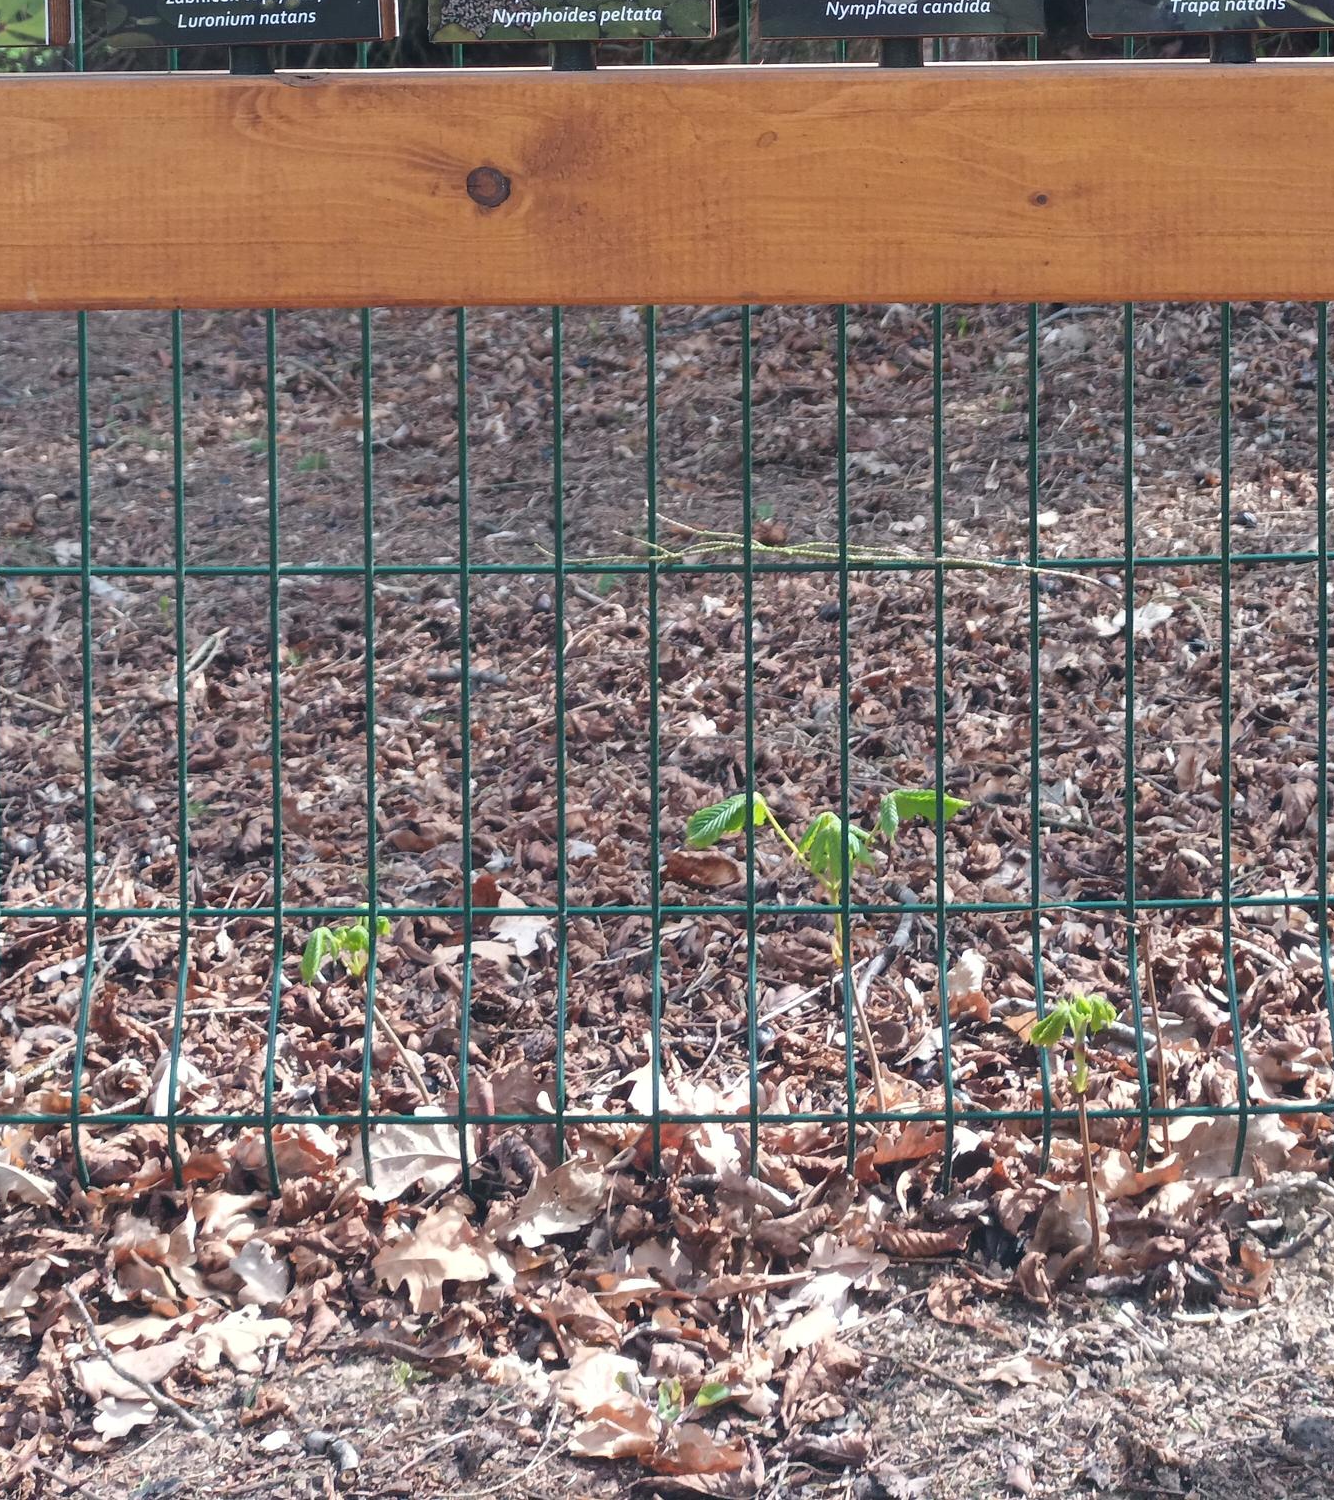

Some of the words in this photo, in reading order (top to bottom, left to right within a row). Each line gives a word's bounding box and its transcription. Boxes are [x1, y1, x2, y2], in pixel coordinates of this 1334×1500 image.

[178, 12, 255, 28] Luronium
[260, 11, 316, 25] natans
[492, 7, 596, 26] Nymphoides
[600, 7, 662, 25] peltata
[826, 1, 917, 20] Nymphaea
